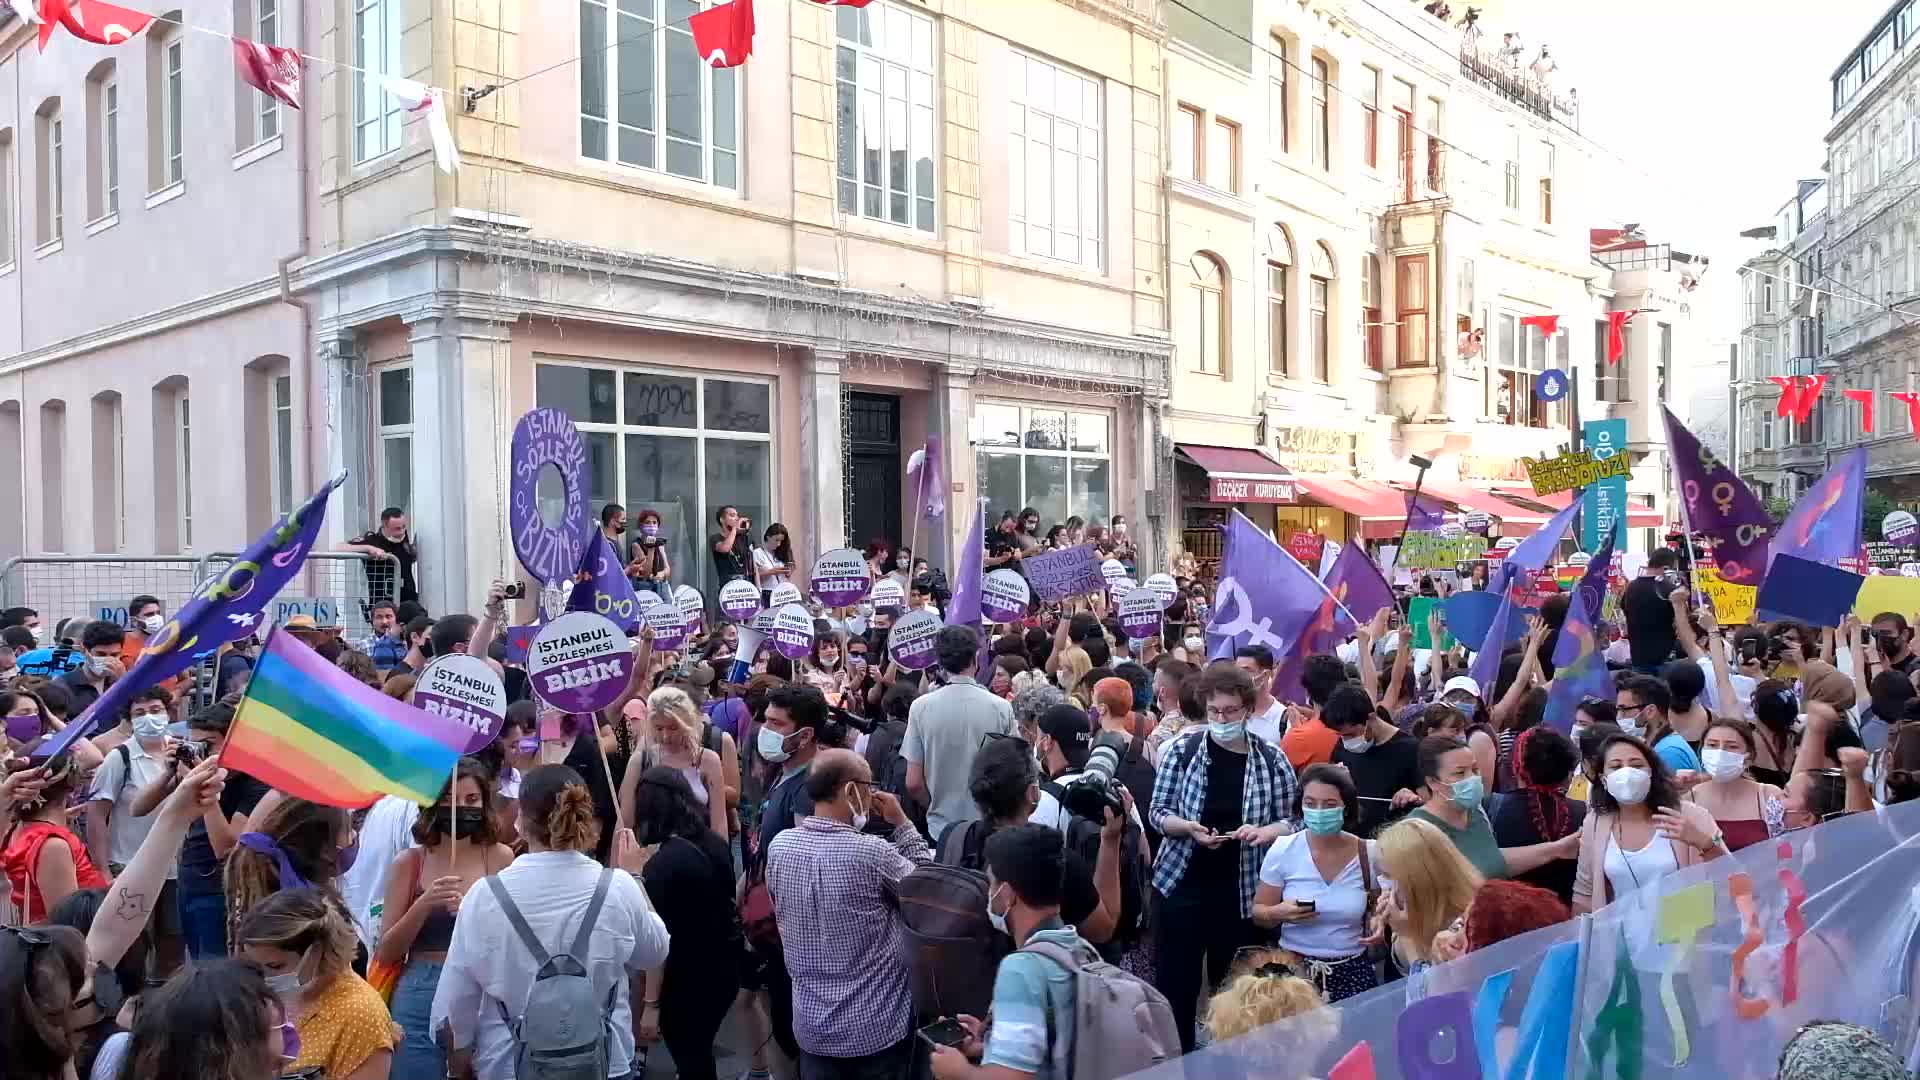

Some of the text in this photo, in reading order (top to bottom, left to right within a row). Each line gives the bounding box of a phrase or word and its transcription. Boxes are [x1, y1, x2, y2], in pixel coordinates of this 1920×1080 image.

[819, 577, 863, 593] BİZİM
[537, 627, 612, 654] İSTANBUL
[777, 629, 809, 648] BİZİM
[541, 640, 614, 667] SÖZLEŞMESİ
[434, 666, 497, 696] İSTANBUL
[544, 658, 625, 694] BİZİM
[431, 681, 495, 709] SÖZLEŞMESİ
